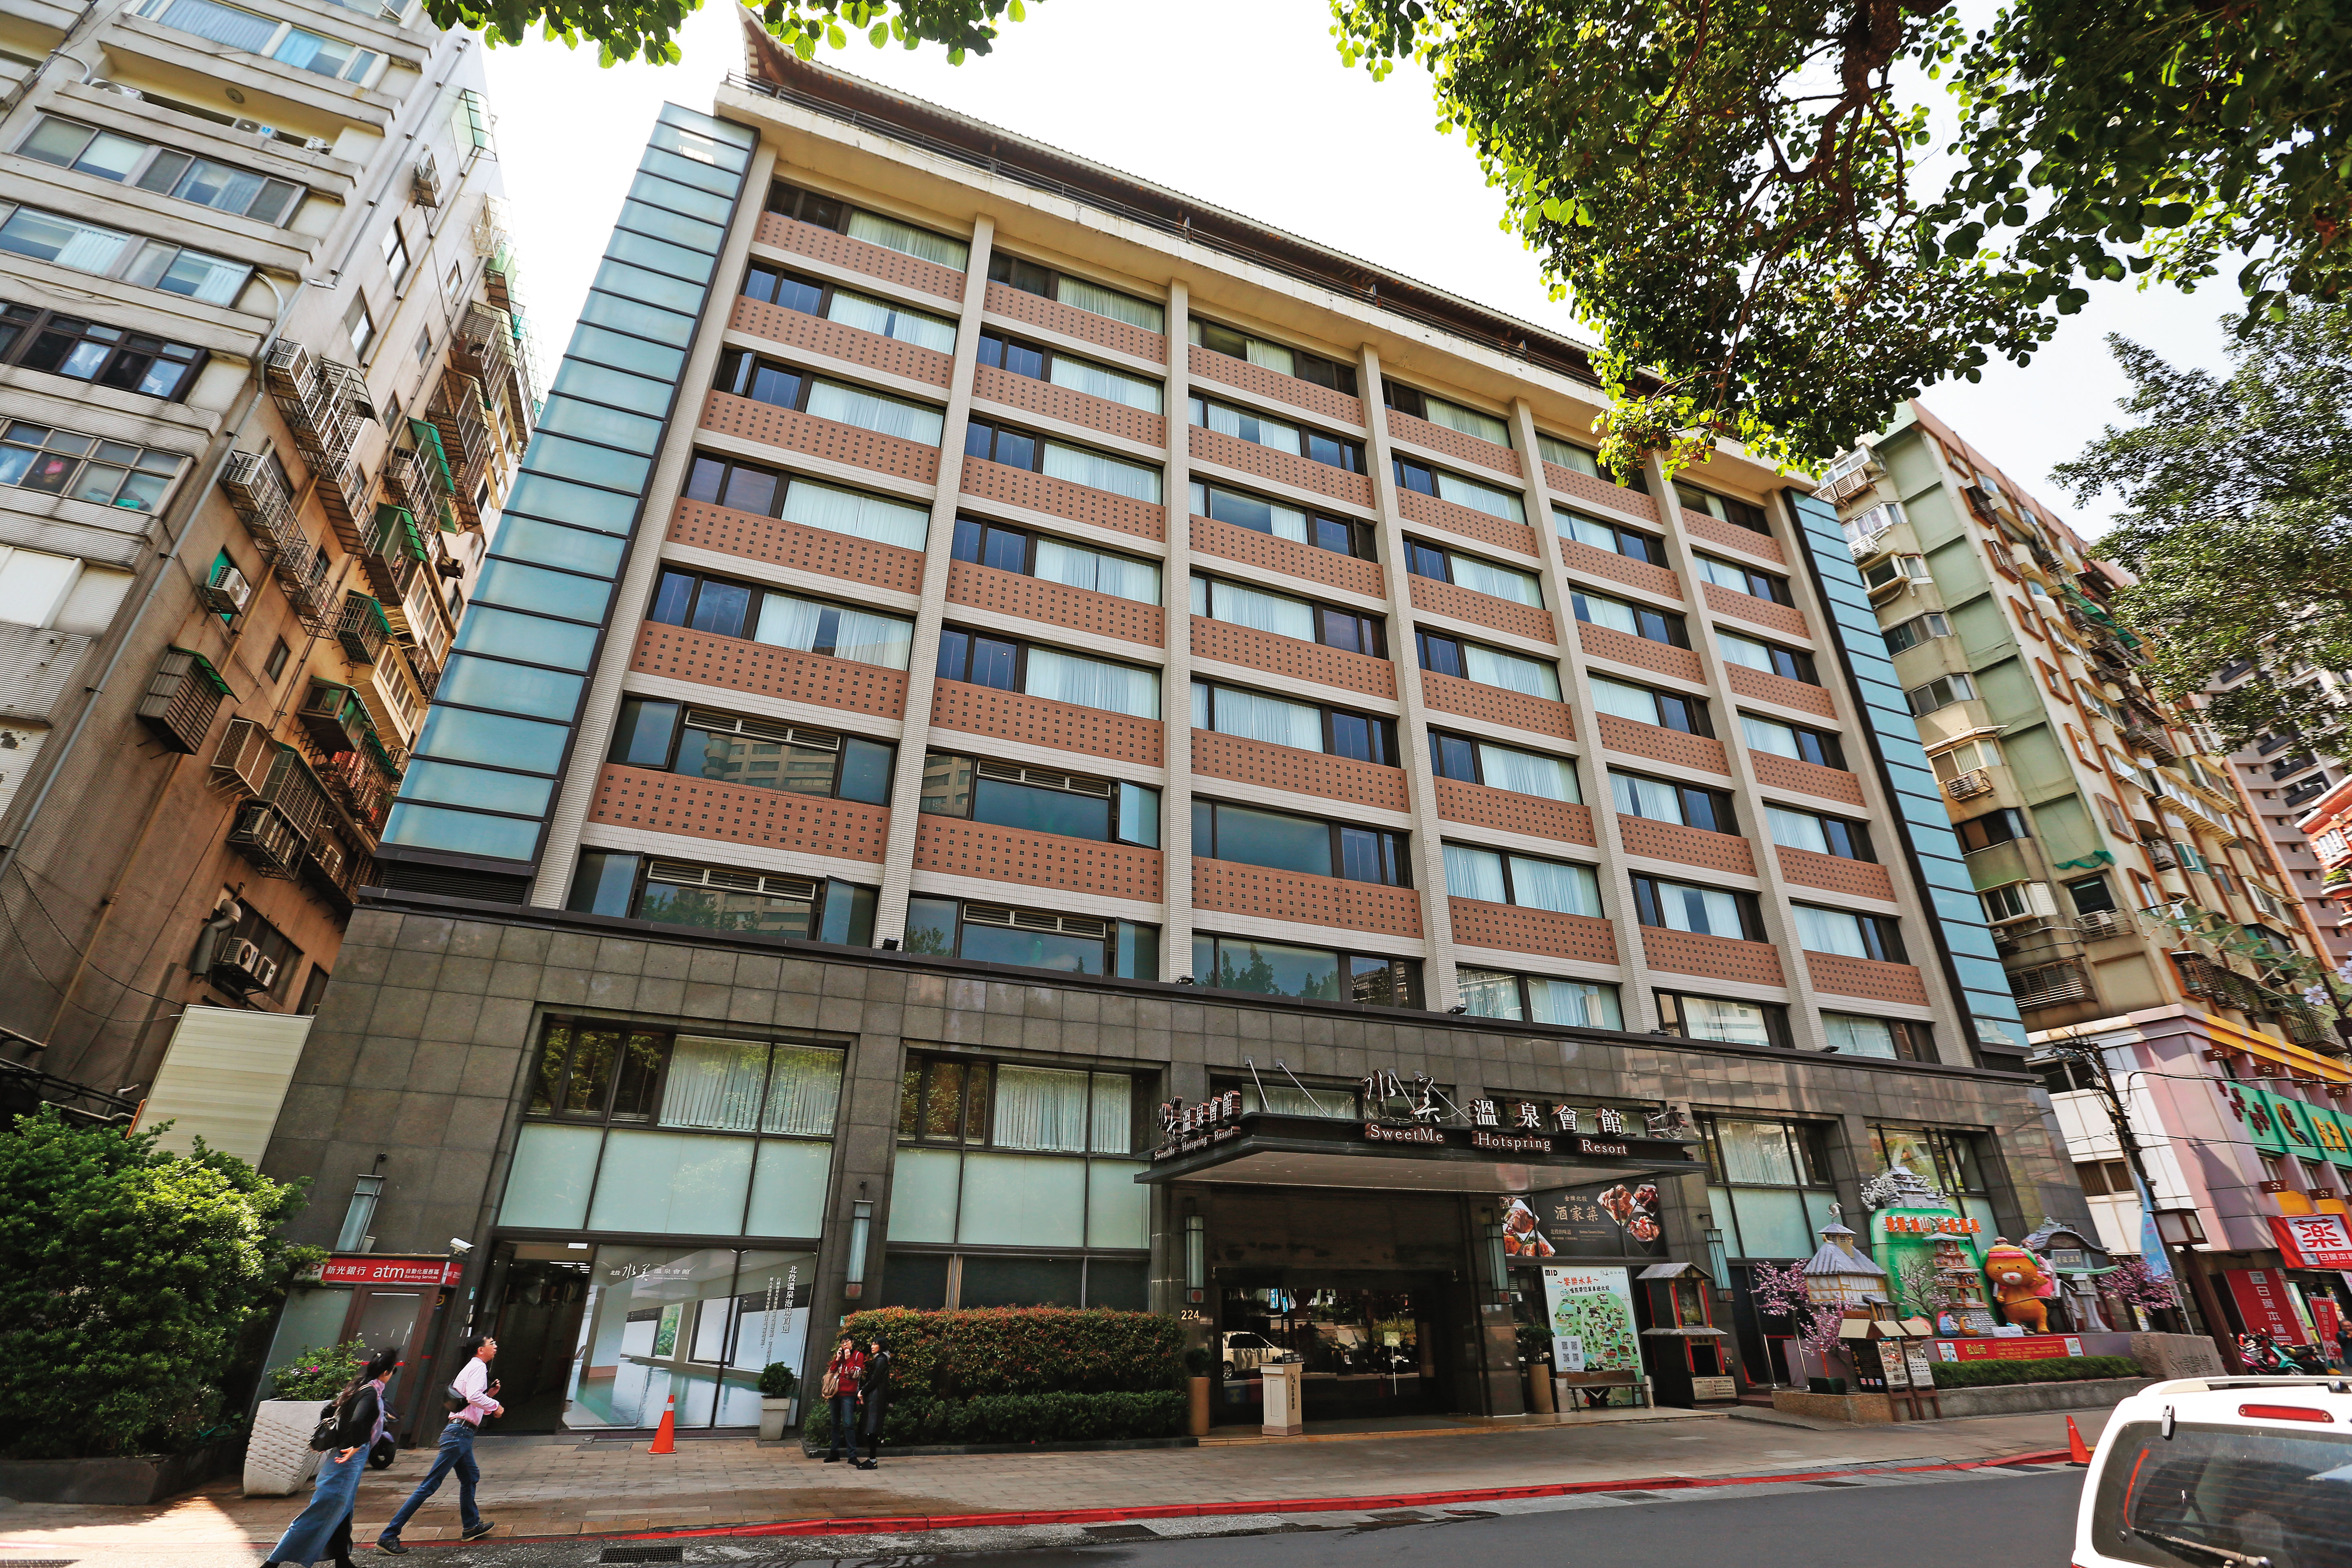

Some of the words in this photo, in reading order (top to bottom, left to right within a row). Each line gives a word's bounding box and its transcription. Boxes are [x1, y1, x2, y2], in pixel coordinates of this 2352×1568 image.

[1473, 1099, 1623, 1134] 溫泉會館
[1154, 1146, 1175, 1160] SweetMe
[1182, 1136, 1207, 1152] Hotspring
[1214, 1127, 1233, 1140] Resort
[1371, 1124, 1443, 1142] SweetMe
[1478, 1132, 1551, 1152] Hotspring
[1581, 1139, 1627, 1154] Resort
[1554, 1205, 1599, 1222] 酒家菜
[325, 1265, 367, 1275] 新光銀行
[373, 1265, 405, 1278] atm
[781, 1265, 798, 1334] 北投溫泉泡湯首選
[1181, 1310, 1200, 1320] 224
